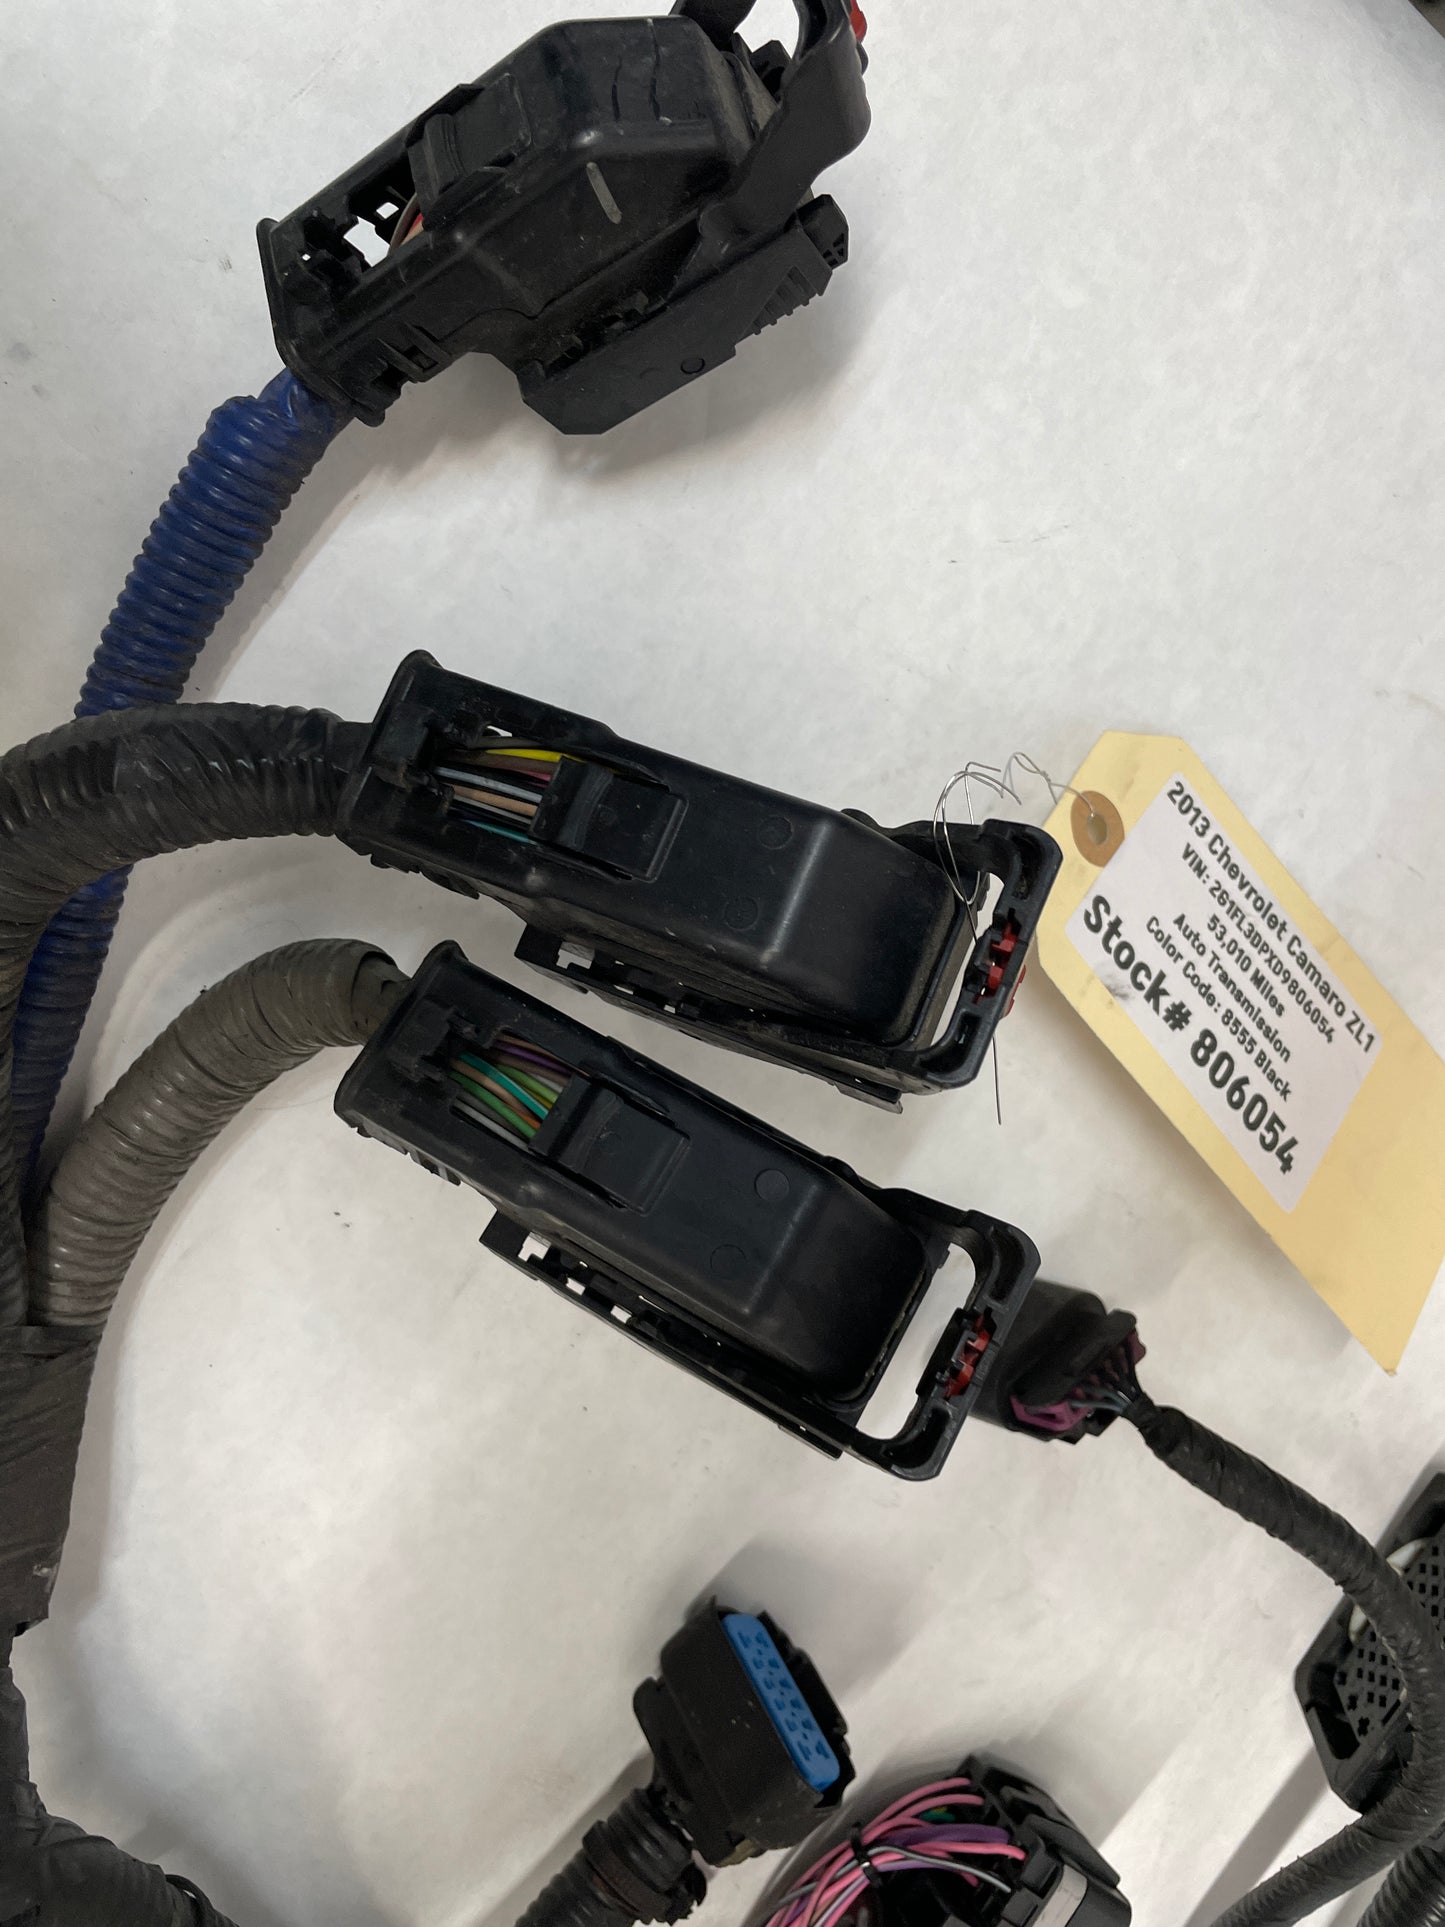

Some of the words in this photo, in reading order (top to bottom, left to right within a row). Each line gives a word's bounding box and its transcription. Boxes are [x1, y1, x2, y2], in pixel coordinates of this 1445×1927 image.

[1167, 781, 1210, 837] 2013
[1208, 834, 1287, 941] Chevrolet
[1287, 935, 1346, 1017] Camaro
[1345, 1012, 1375, 1053] ZL1
[1182, 843, 1210, 884] VIN:
[1083, 895, 1192, 1031] Stock#
[1190, 1028, 1299, 1175] 806054
[1146, 916, 1184, 963] Color
[1182, 961, 1221, 1013] Code:
[1221, 1008, 1258, 1055] 8555
[1254, 1049, 1291, 1102] Black
[1173, 914, 1206, 956] Auto
[1208, 951, 1291, 1063] Transmission
[1207, 914, 1252, 972] 53,010
[1250, 968, 1285, 1017] Miles
